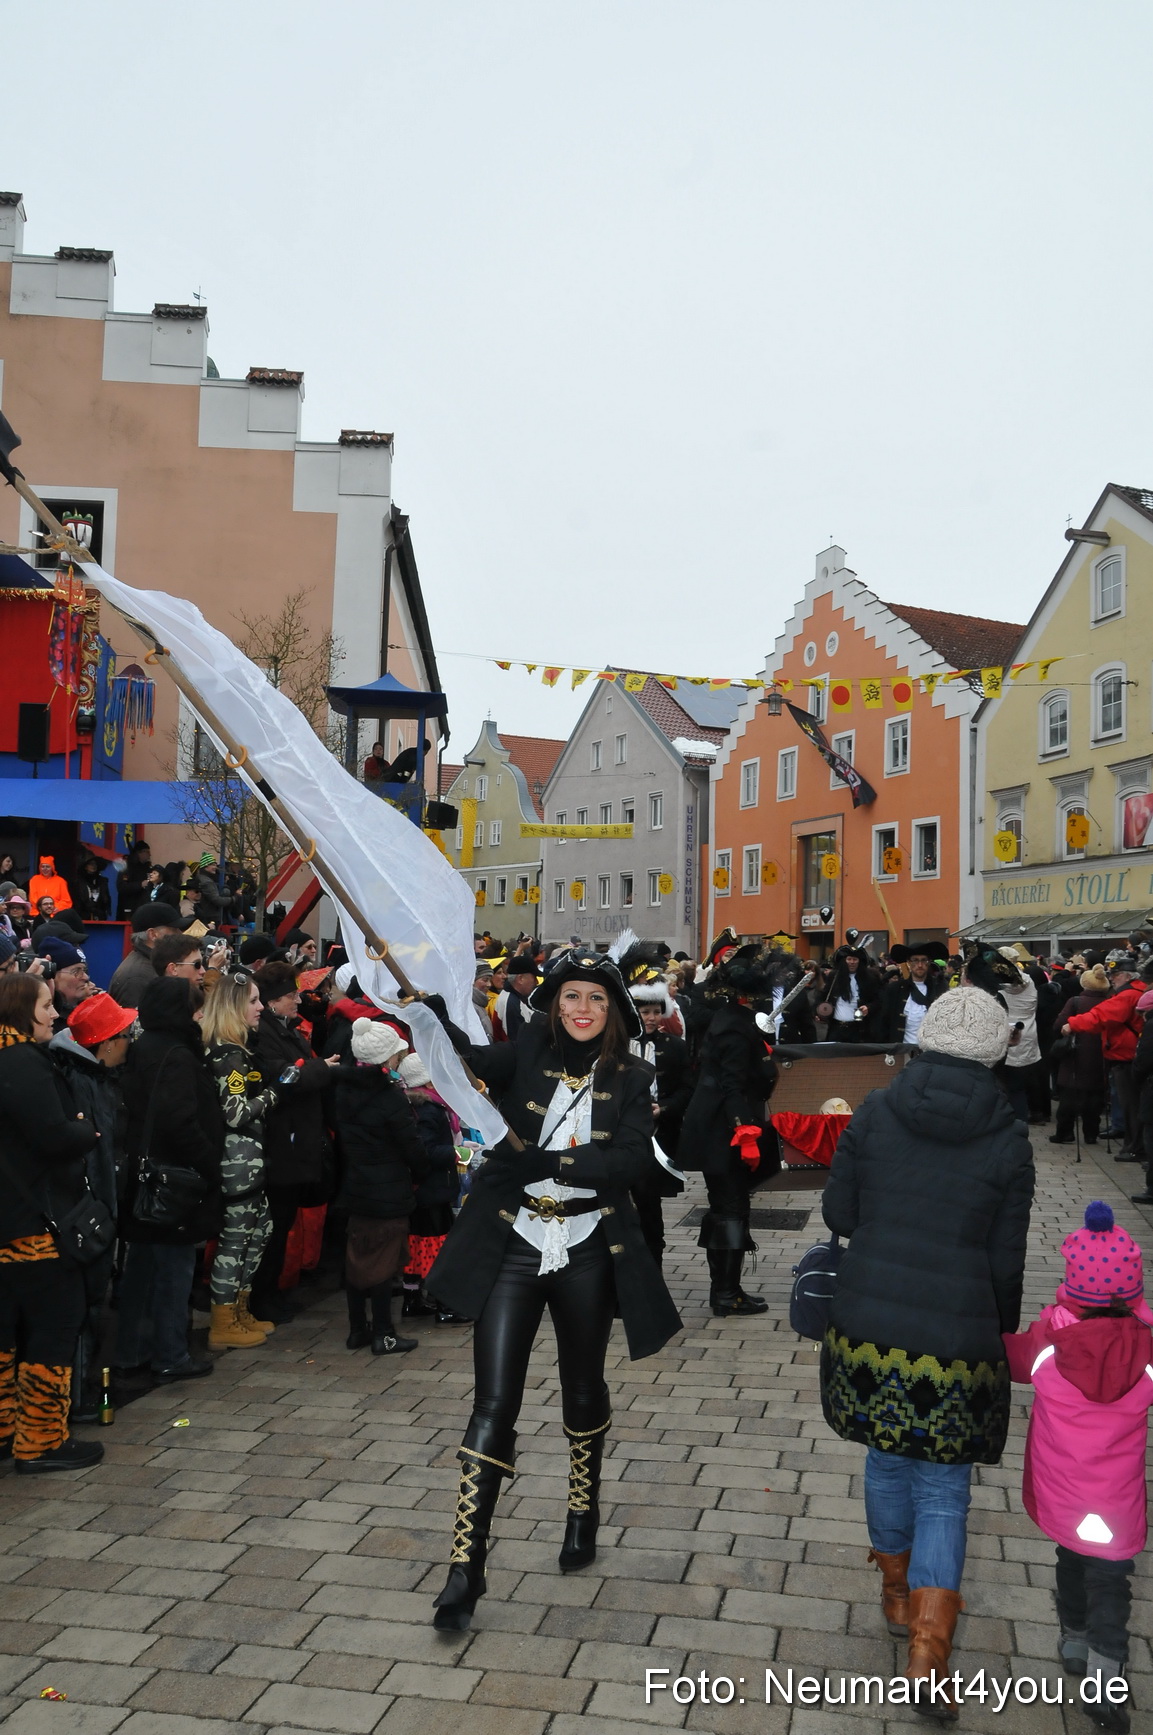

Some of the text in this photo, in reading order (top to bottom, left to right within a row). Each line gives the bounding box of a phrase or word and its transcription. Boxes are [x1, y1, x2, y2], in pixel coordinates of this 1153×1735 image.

[684, 805, 694, 924] UHREN SCHMUCK
[991, 883, 1051, 906] BÄCKEREI
[1063, 872, 1130, 907] STOLL
[574, 916, 602, 934] OPTIK
